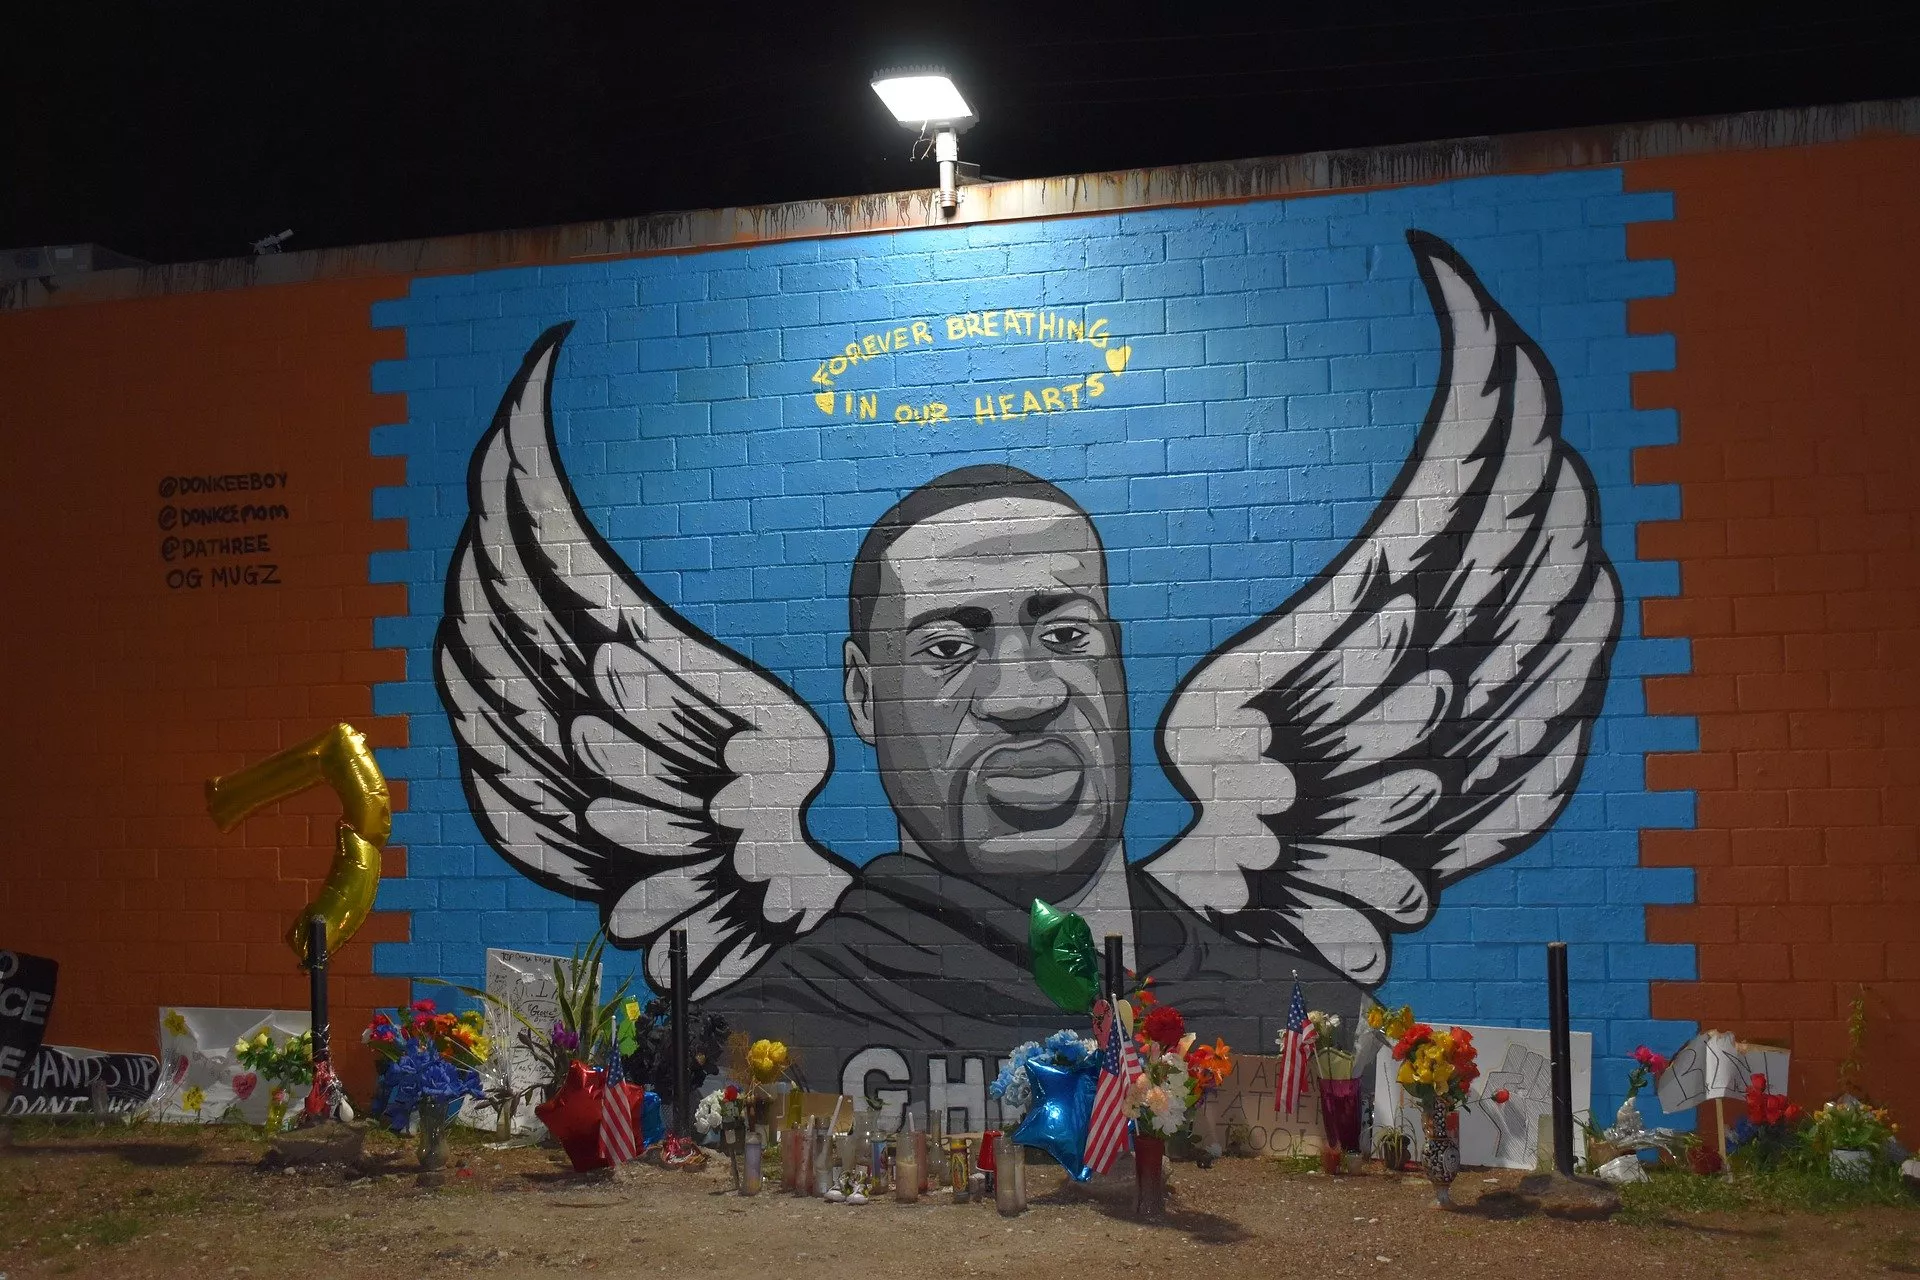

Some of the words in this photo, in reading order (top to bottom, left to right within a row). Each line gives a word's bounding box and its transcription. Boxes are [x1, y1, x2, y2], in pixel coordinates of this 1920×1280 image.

[812, 320, 934, 387] FOREVER
[946, 309, 1111, 349] BREATHING
[845, 393, 877, 420] IN
[894, 402, 949, 426] OUR
[973, 372, 1106, 425] HEARTS
[158, 471, 288, 498] @DONKEEBOY
[162, 534, 271, 562] @DATHREE
[166, 567, 203, 589] OG
[211, 564, 281, 588] MUGZ
[22, 1050, 121, 1089] HANDS
[125, 1056, 158, 1092] UP
